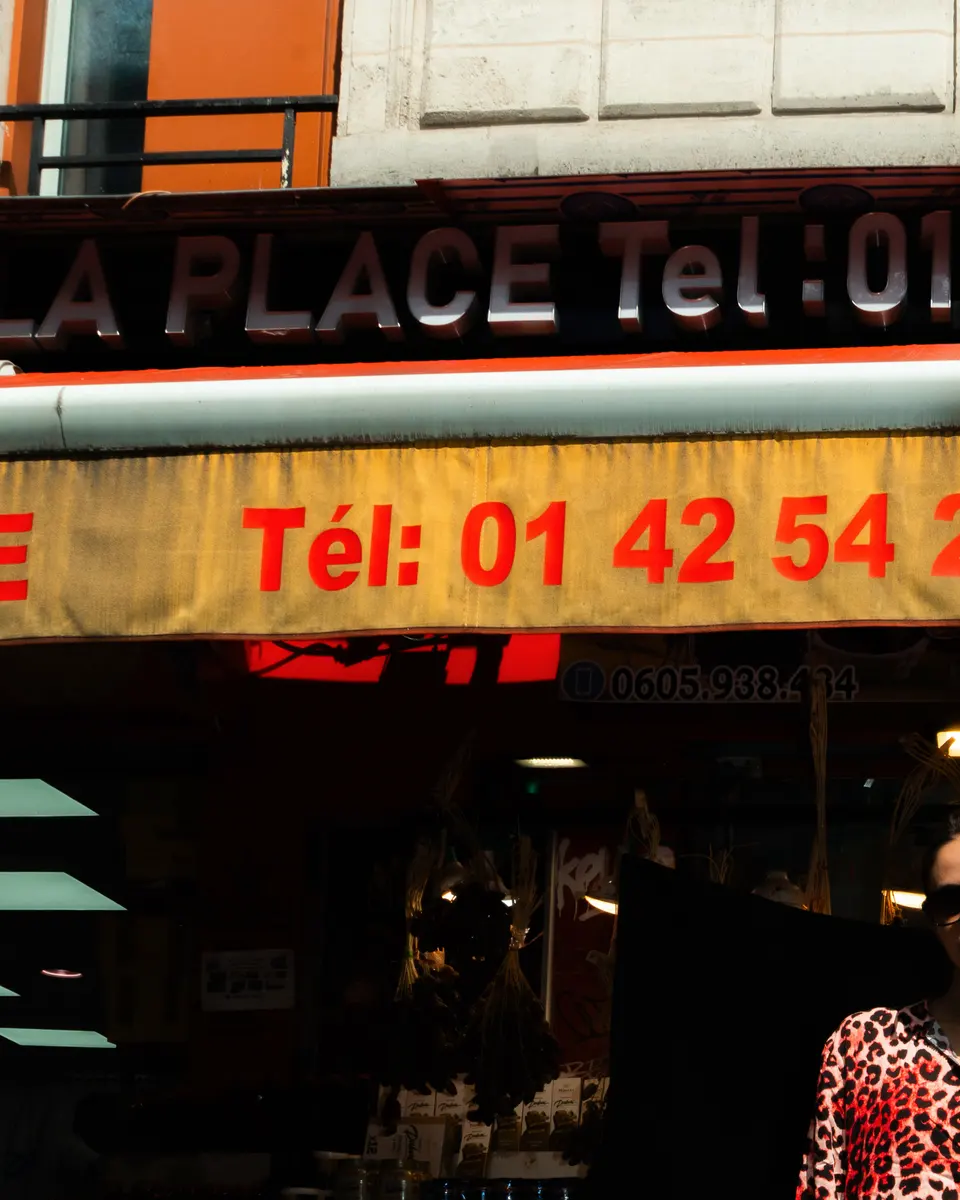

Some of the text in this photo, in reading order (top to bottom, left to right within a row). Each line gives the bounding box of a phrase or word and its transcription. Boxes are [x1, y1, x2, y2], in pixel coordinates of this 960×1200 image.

[165, 224, 561, 344] PLACE
[598, 216, 770, 331] Tel
[242, 504, 422, 591] Tél:
[460, 500, 566, 587] 01
[612, 497, 735, 584] 42
[771, 493, 895, 581] 54
